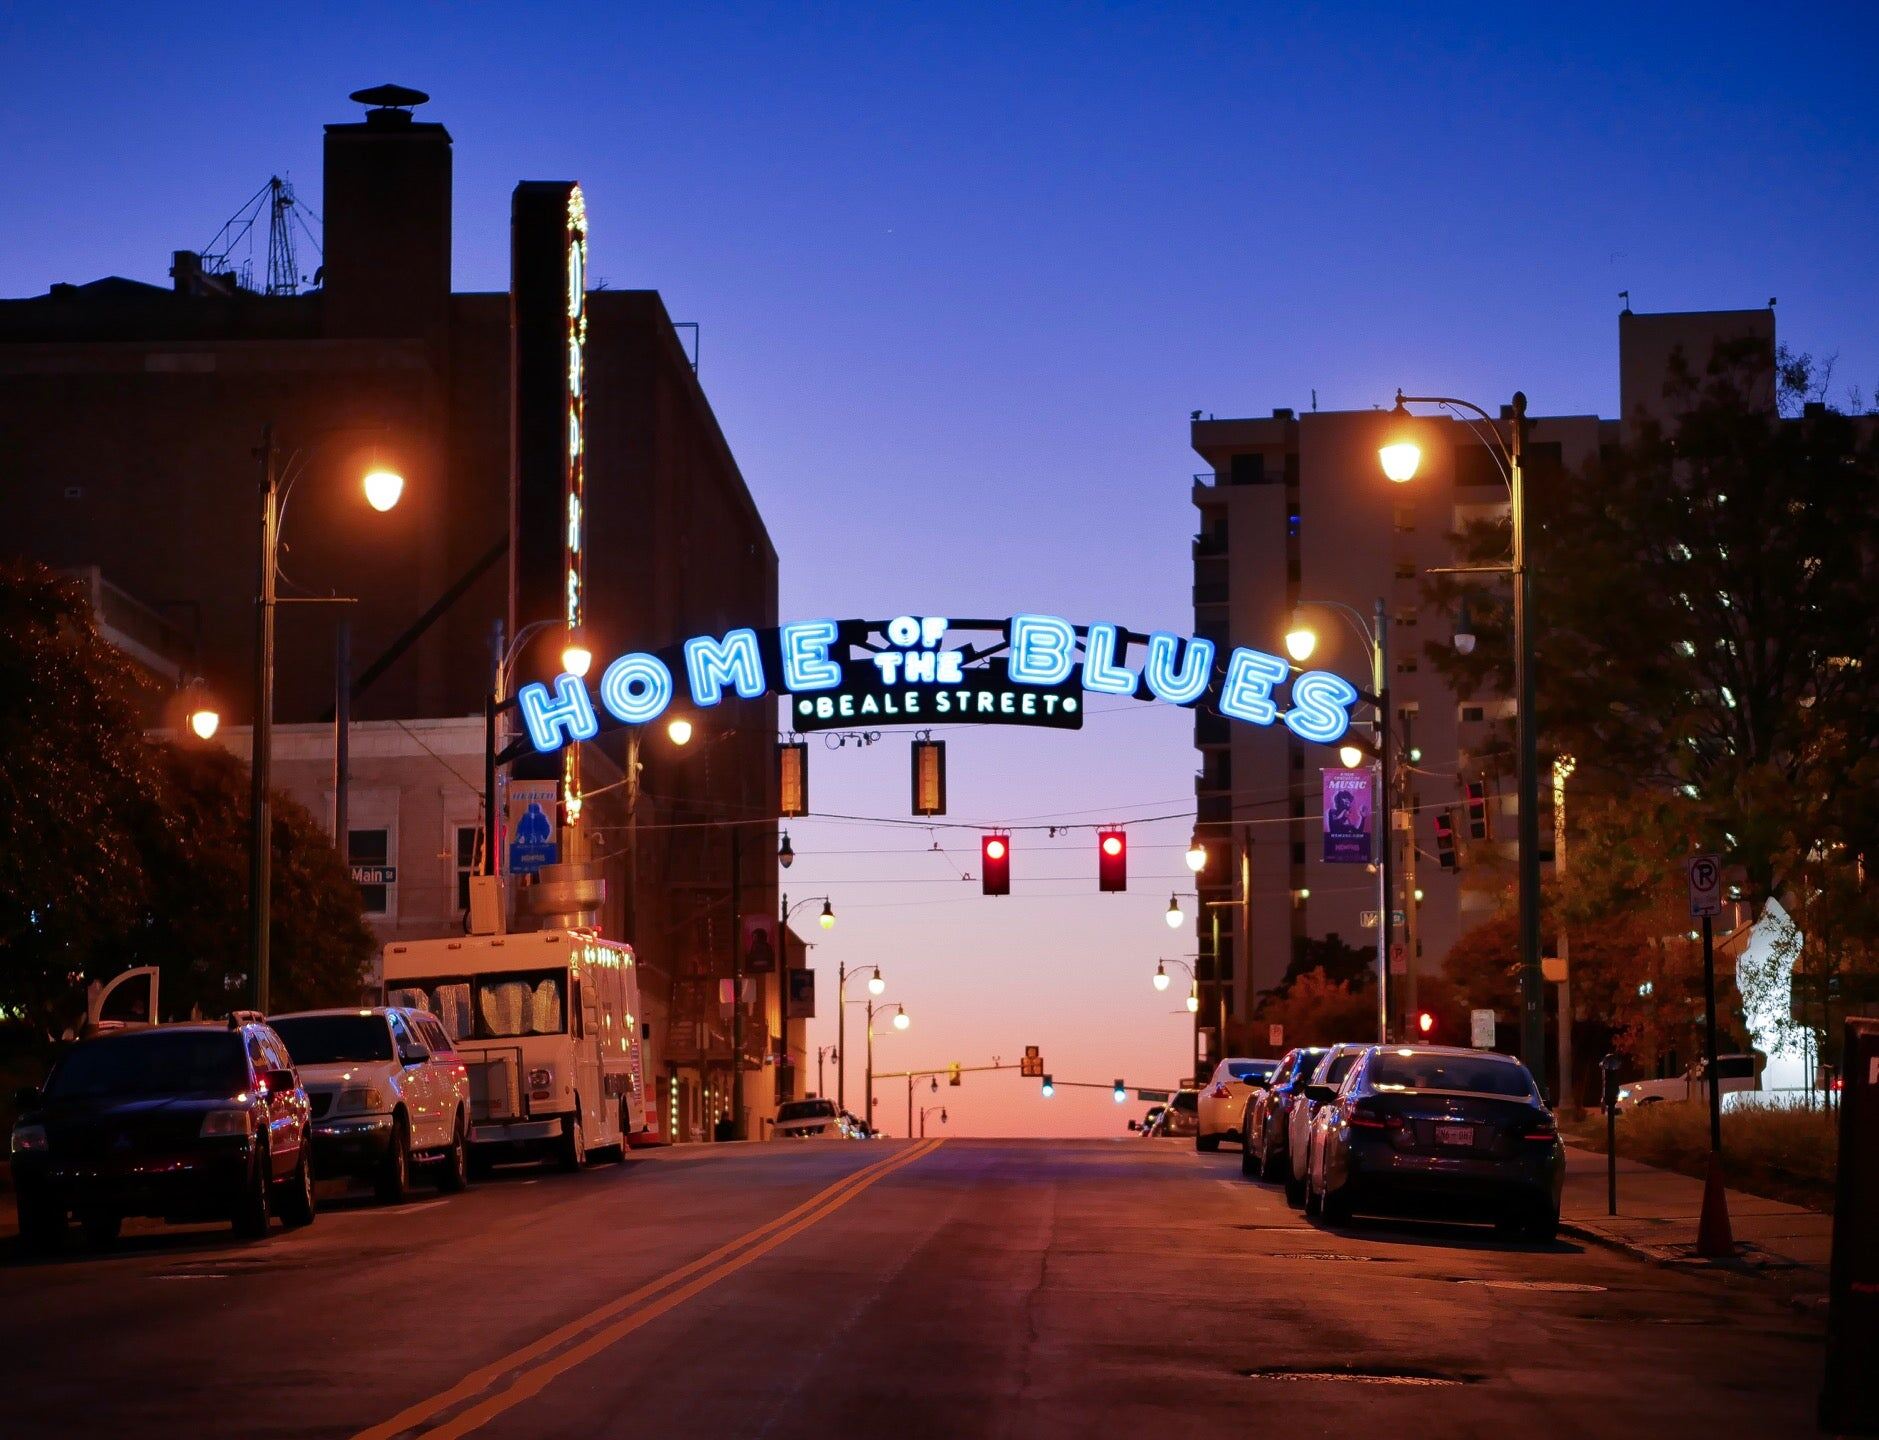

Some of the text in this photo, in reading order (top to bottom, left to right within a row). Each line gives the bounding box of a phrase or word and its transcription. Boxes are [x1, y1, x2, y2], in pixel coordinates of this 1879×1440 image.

[887, 616, 948, 648] OF
[874, 651, 963, 684] THE
[1009, 613, 1358, 744] BLUES
[519, 620, 841, 751] HOME
[818, 692, 1060, 717] BEALE STREET
[1328, 780, 1367, 789] MUSIC
[351, 867, 382, 882] Main
